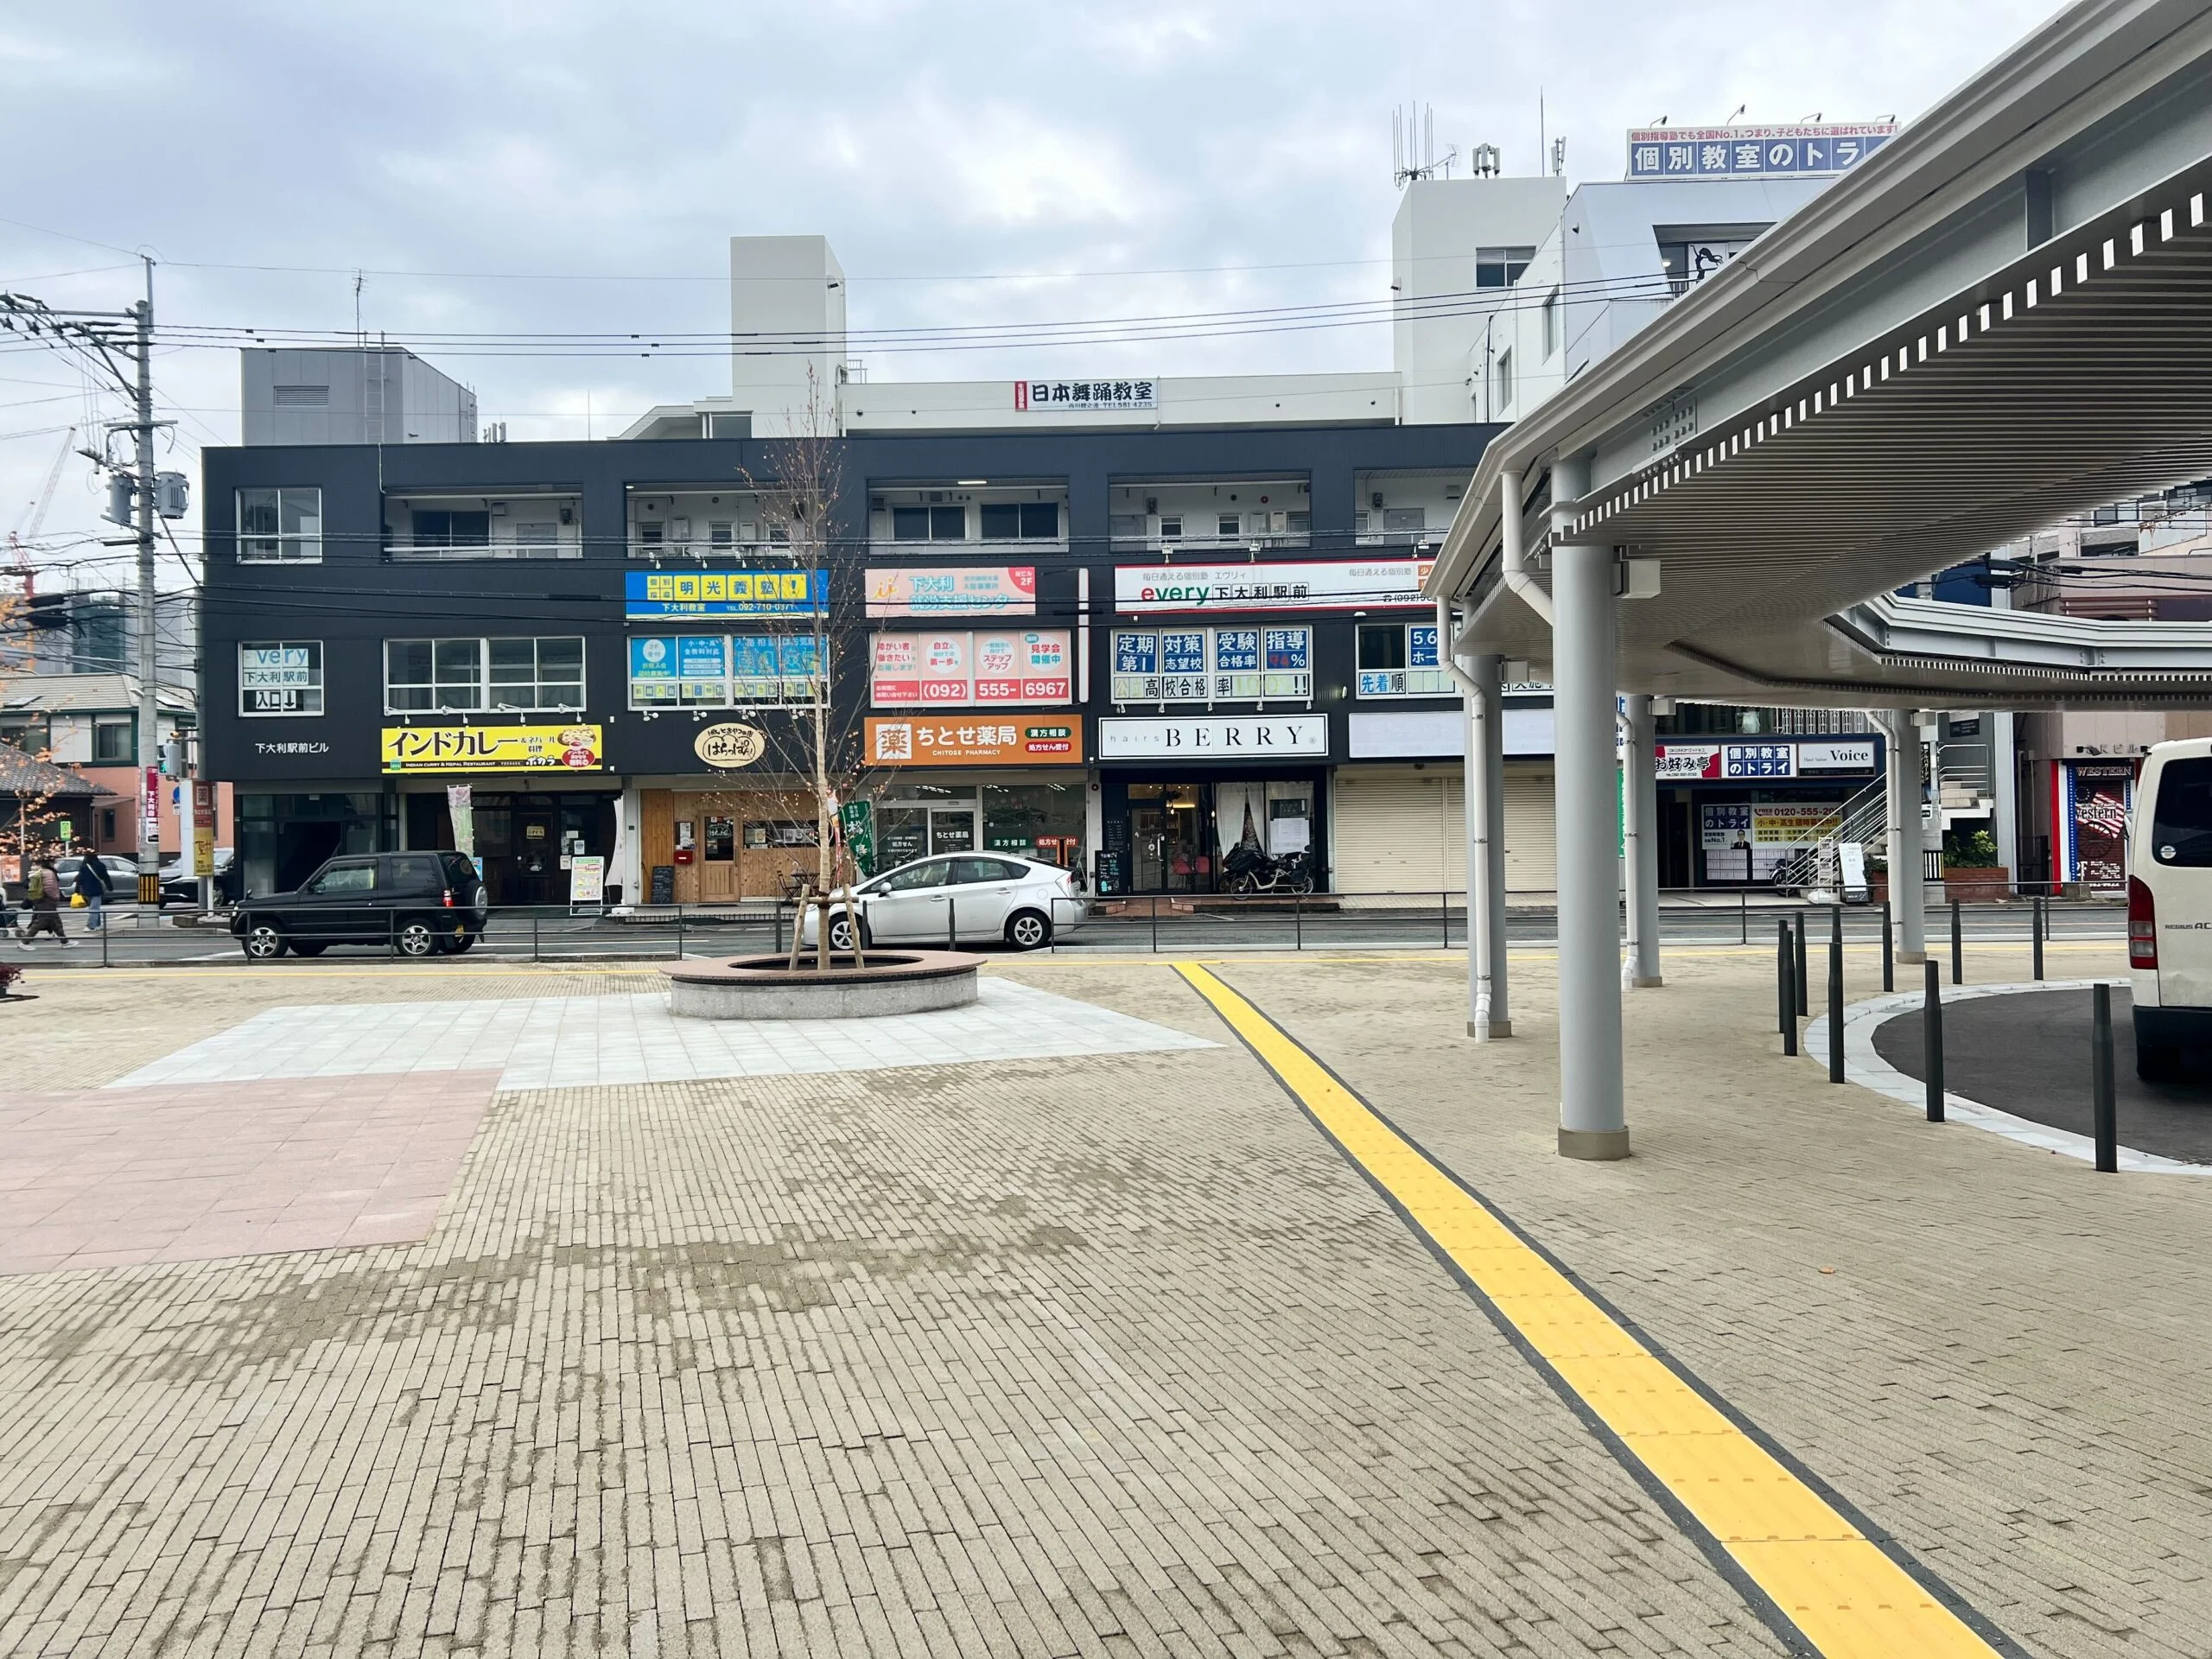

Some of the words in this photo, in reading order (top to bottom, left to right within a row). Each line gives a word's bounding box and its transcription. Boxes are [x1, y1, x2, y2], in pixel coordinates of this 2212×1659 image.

[1032, 381, 1153, 402] 日本舞踊教室
[1143, 572, 1209, 581] 毎日通える個別塾
[1350, 568, 1412, 576] 毎日通える個別塾
[909, 575, 954, 592] 下大利
[1020, 577, 1033, 586] 2F
[1141, 585, 1210, 605] every
[1215, 584, 1309, 601] 下大利駅前
[662, 602, 706, 612] 下大利教室
[1118, 634, 1154, 654] 定期
[1164, 634, 1201, 653] 対策
[1217, 632, 1256, 652] 受験
[1267, 631, 1305, 650] 指導
[1031, 644, 1060, 653] 見学会
[257, 649, 308, 666] very
[983, 654, 1012, 663] ステップ
[1031, 654, 1060, 664] 開催中
[1165, 656, 1203, 671] 志望校
[1217, 654, 1256, 668] 合格率
[987, 662, 1008, 671] アップ
[244, 671, 308, 683] 下大利駅前
[1361, 674, 1404, 692] 先着順
[924, 683, 967, 697] (092)
[978, 683, 1016, 696] 555-
[1025, 682, 1066, 696] 6967
[257, 691, 282, 708] 入口
[917, 725, 1017, 747] ちとせ薬局
[1030, 728, 1067, 737] 漢方相談
[1109, 734, 1160, 742] hairs
[1166, 725, 1303, 747] BERRY
[255, 741, 329, 754] 下大利駅前ビル
[388, 731, 518, 757] インドカレー
[880, 729, 907, 754] 薬
[1028, 743, 1069, 752] 処方せん受付
[528, 745, 543, 753] 料理
[1729, 746, 1789, 760] 個別教室
[1830, 748, 1869, 761] Voice
[1655, 756, 1710, 772] お好み亭
[1729, 761, 1789, 776] のトライ
[2075, 766, 2132, 777] WESTERN
[1705, 806, 1750, 817] 個別教室
[1705, 819, 1750, 829] のトライ
[936, 830, 969, 839] ちとせ薬局
